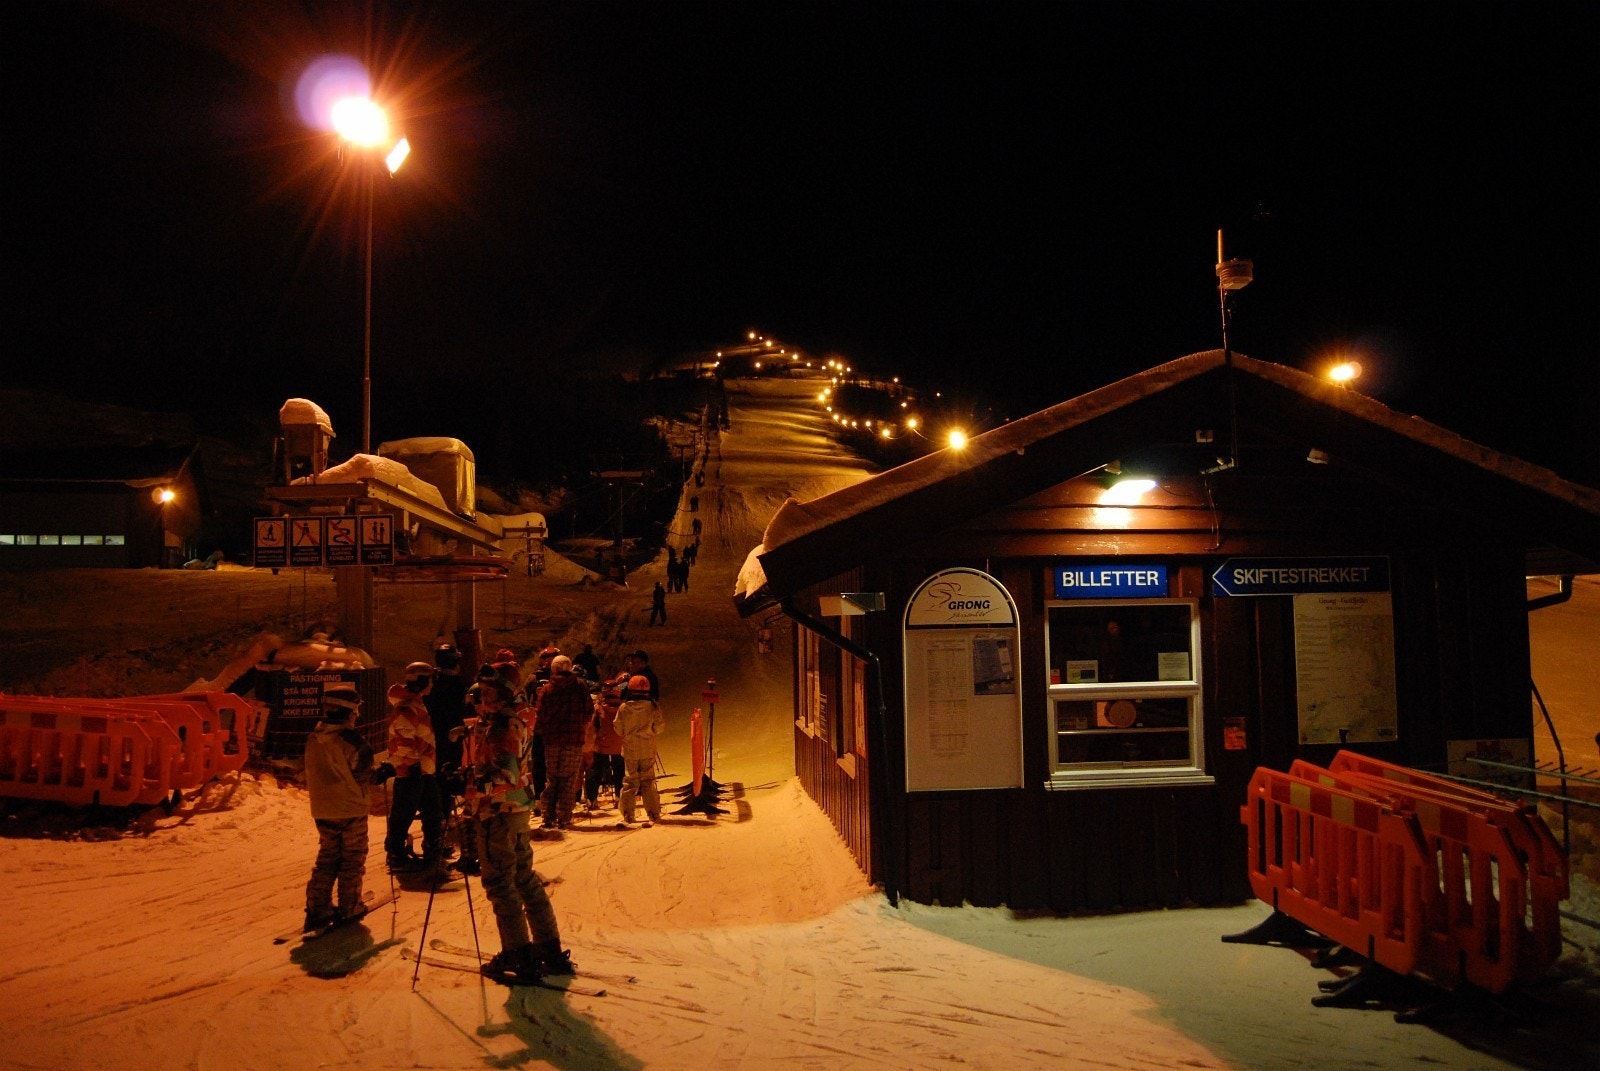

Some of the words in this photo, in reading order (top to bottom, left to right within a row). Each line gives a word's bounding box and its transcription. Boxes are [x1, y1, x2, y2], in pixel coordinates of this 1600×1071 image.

[1062, 570, 1159, 587] BILLETTER
[1233, 567, 1370, 585] SKIFTESTREKKET
[948, 600, 990, 610] GRONG
[290, 674, 342, 683] PÅSTIGNING
[283, 686, 299, 695] STÅ
[301, 687, 319, 695] MOT
[283, 698, 318, 706] KROKEN
[282, 708, 301, 716] IKKE
[302, 708, 320, 716] SITT
